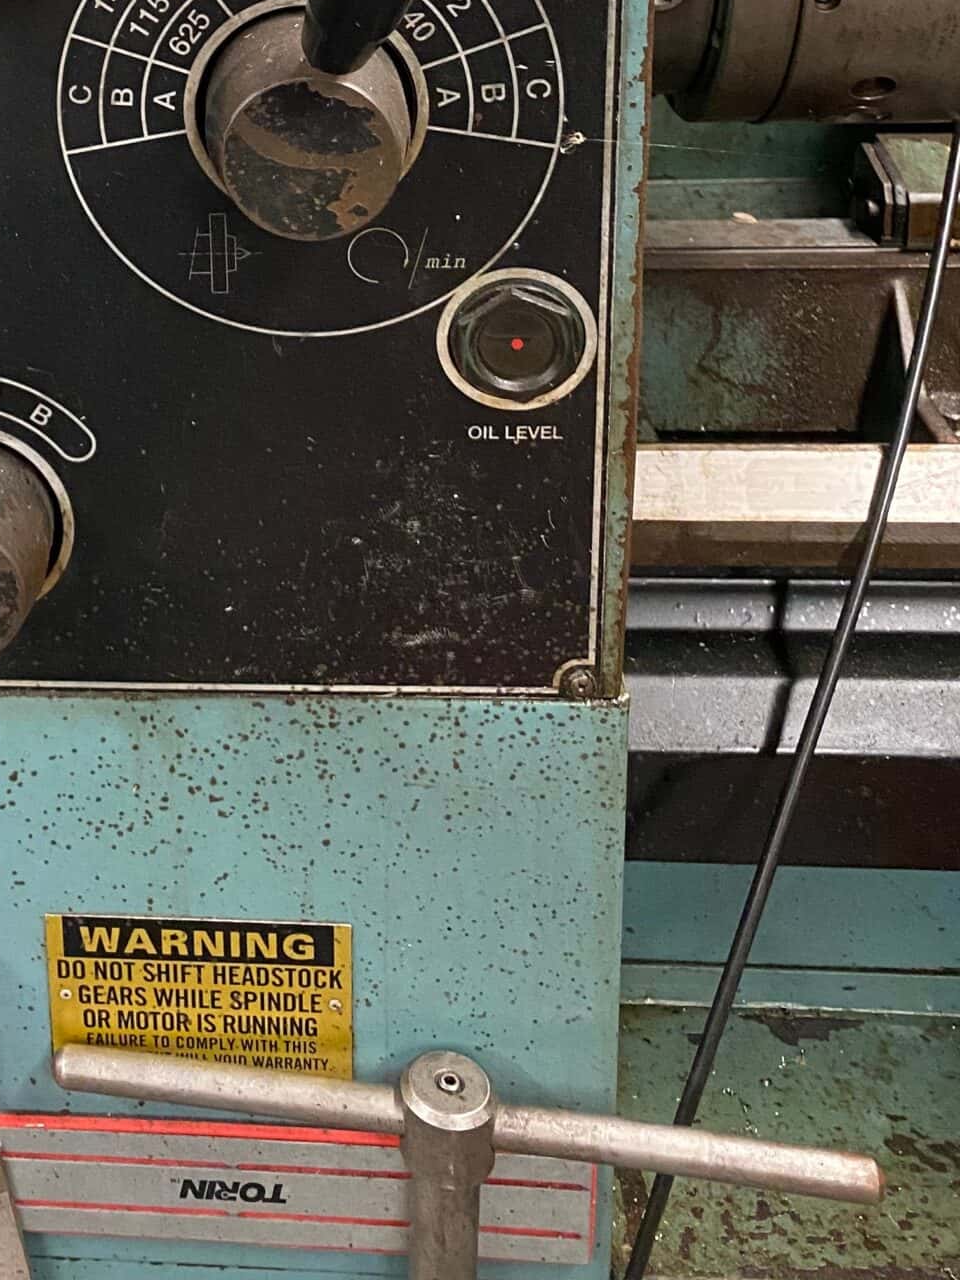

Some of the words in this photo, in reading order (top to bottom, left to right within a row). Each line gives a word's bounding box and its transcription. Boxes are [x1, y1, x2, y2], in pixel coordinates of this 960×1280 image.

[167, 9, 212, 57] 625
[403, 12, 436, 42] 40
[69, 84, 93, 106] C
[111, 86, 135, 108] B
[153, 89, 178, 111] A
[436, 87, 462, 107] A
[481, 82, 507, 104] B
[526, 78, 551, 100] C
[30, 403, 54, 427] B
[467, 425, 502, 440] OIL
[505, 424, 563, 441] LEVEL
[79, 925, 316, 961] WARNING
[56, 959, 86, 979] DO
[94, 961, 136, 981] NOT
[143, 963, 206, 985] SHIFT
[212, 966, 343, 990] HEADSTOCK
[78, 985, 147, 1007] GEARS
[153, 988, 223, 1010] WHILE
[230, 991, 323, 1014] SPINDLE
[83, 1009, 113, 1029] OR
[118, 1011, 191, 1033] MOTOR
[197, 1014, 217, 1033] IS
[222, 1016, 319, 1038] RUNNING
[87, 1032, 147, 1048] FAILURE
[154, 1035, 170, 1049] TO
[176, 1036, 235, 1051] COMPLY
[241, 1038, 279, 1053] WITH
[285, 1040, 317, 1055] THIS
[179, 1178, 288, 1205] TORIN
